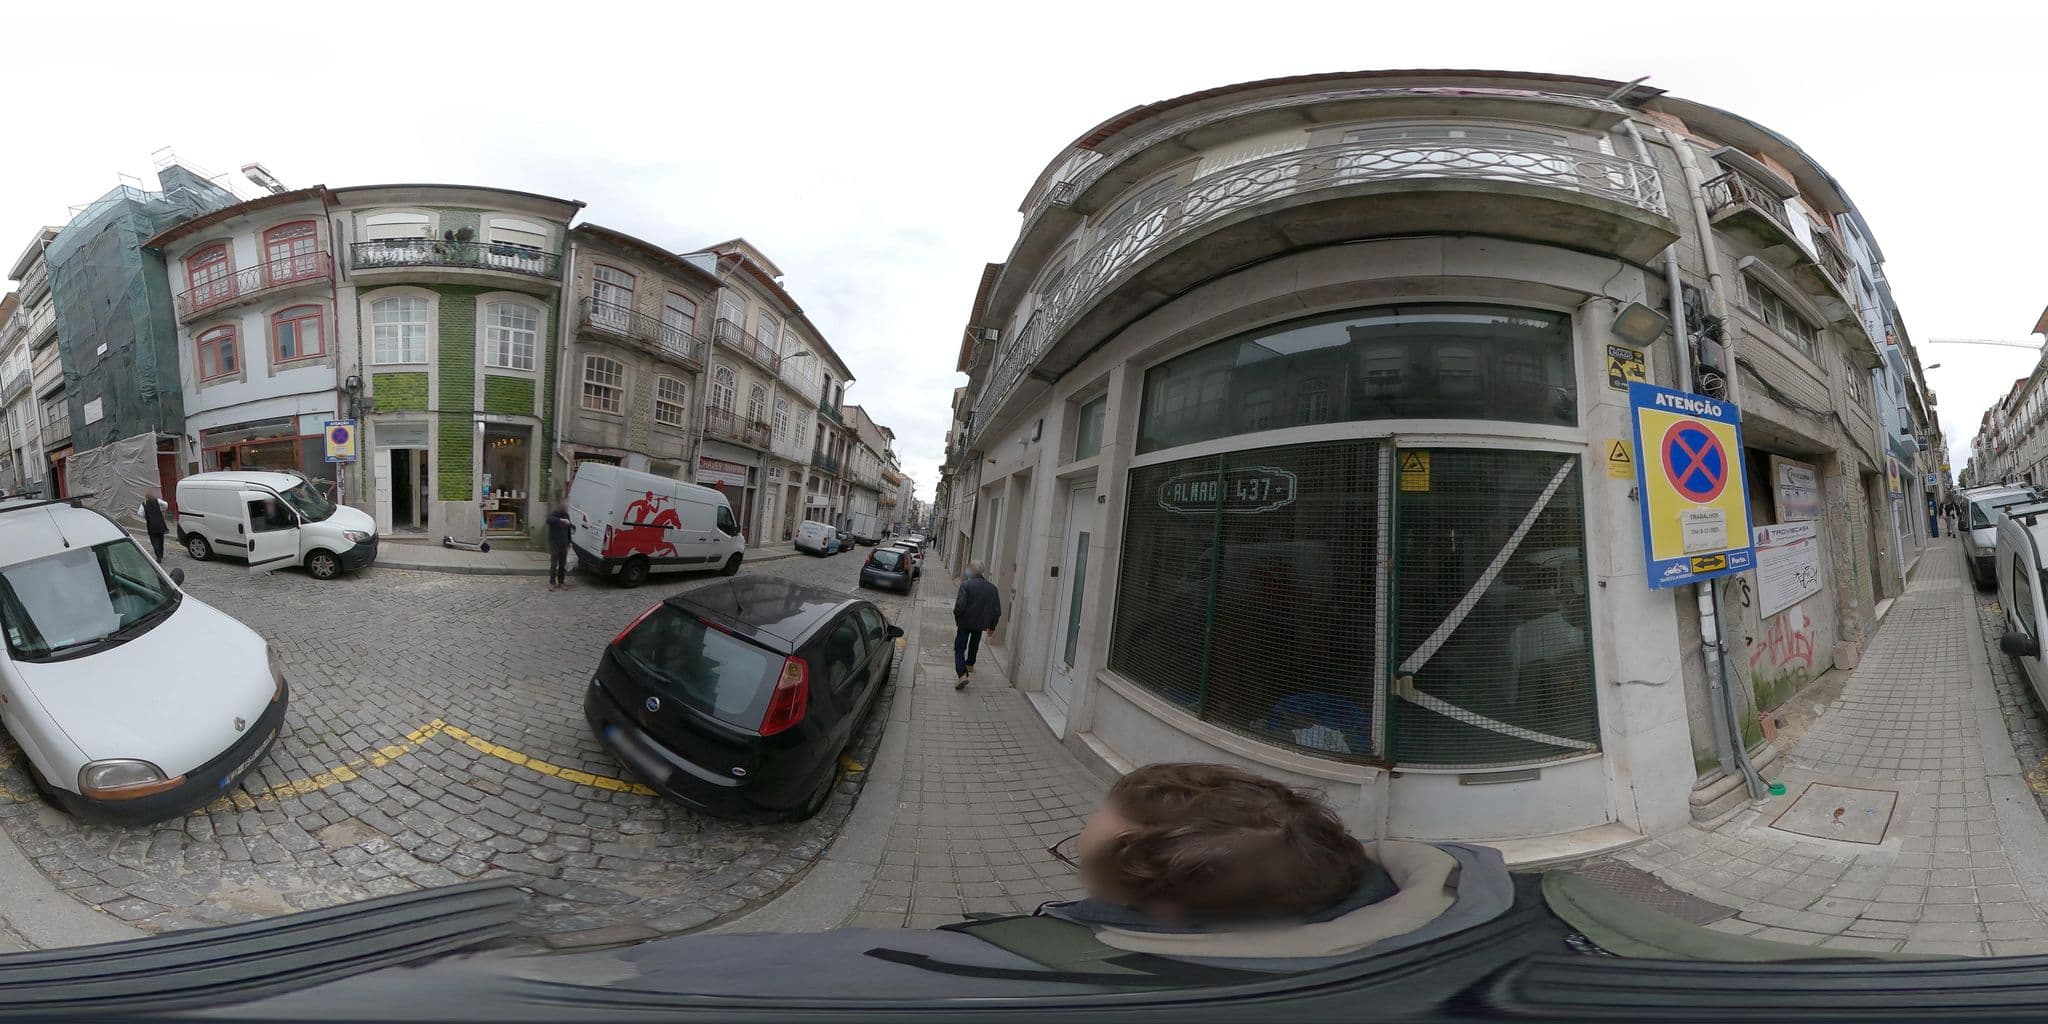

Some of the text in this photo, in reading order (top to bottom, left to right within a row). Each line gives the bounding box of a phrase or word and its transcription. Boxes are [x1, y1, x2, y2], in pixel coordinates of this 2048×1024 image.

[1655, 392, 1722, 417] ATENÇÃO
[1236, 478, 1271, 501] 437
[1690, 512, 1720, 520] TRABALHOS
